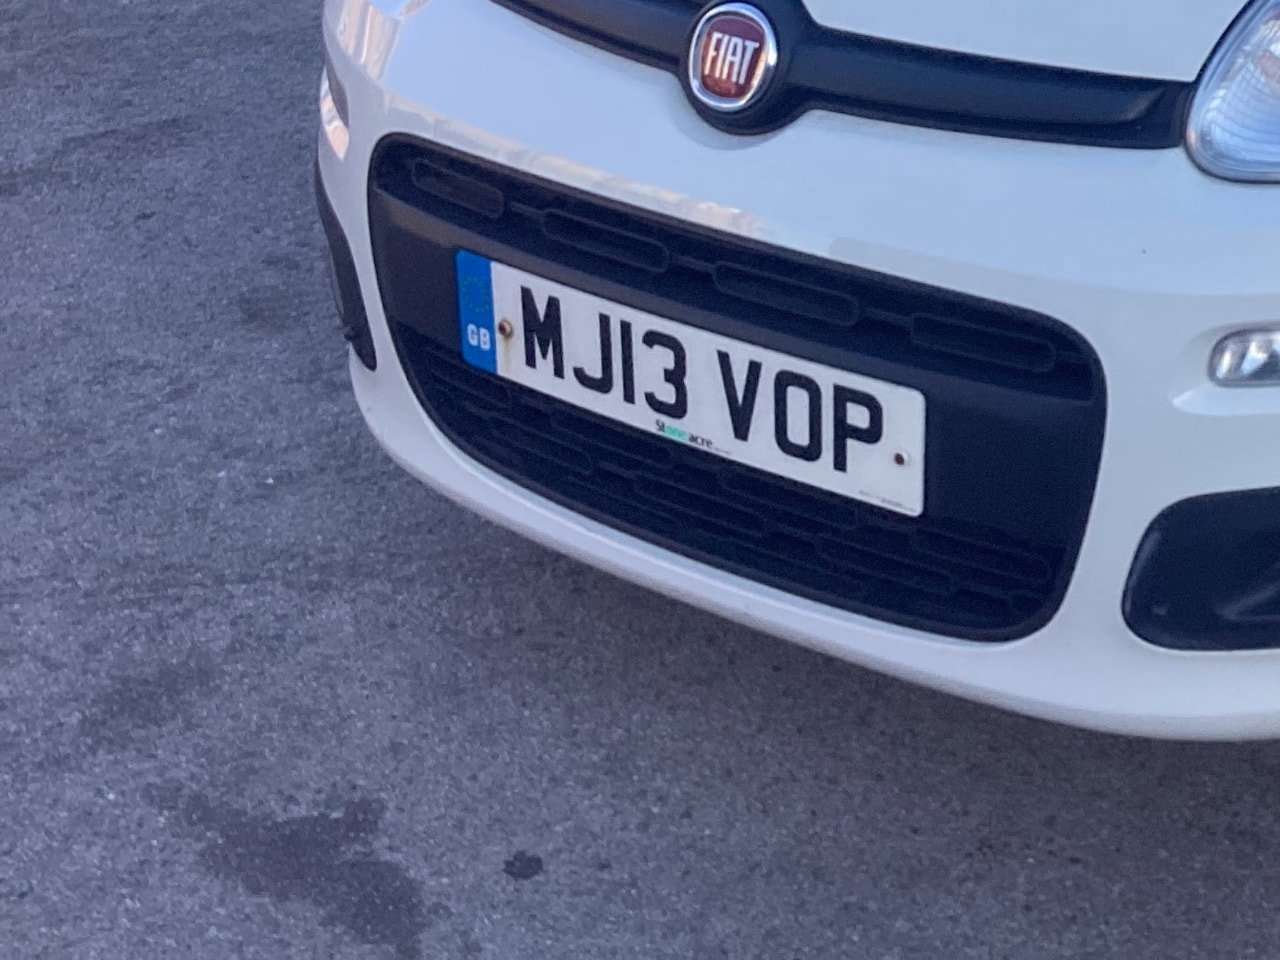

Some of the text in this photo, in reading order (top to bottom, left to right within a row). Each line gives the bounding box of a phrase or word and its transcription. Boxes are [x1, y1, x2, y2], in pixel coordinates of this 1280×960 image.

[704, 31, 760, 85] FIAT
[467, 323, 491, 351] GB
[520, 285, 883, 473] MJ13 VOP
